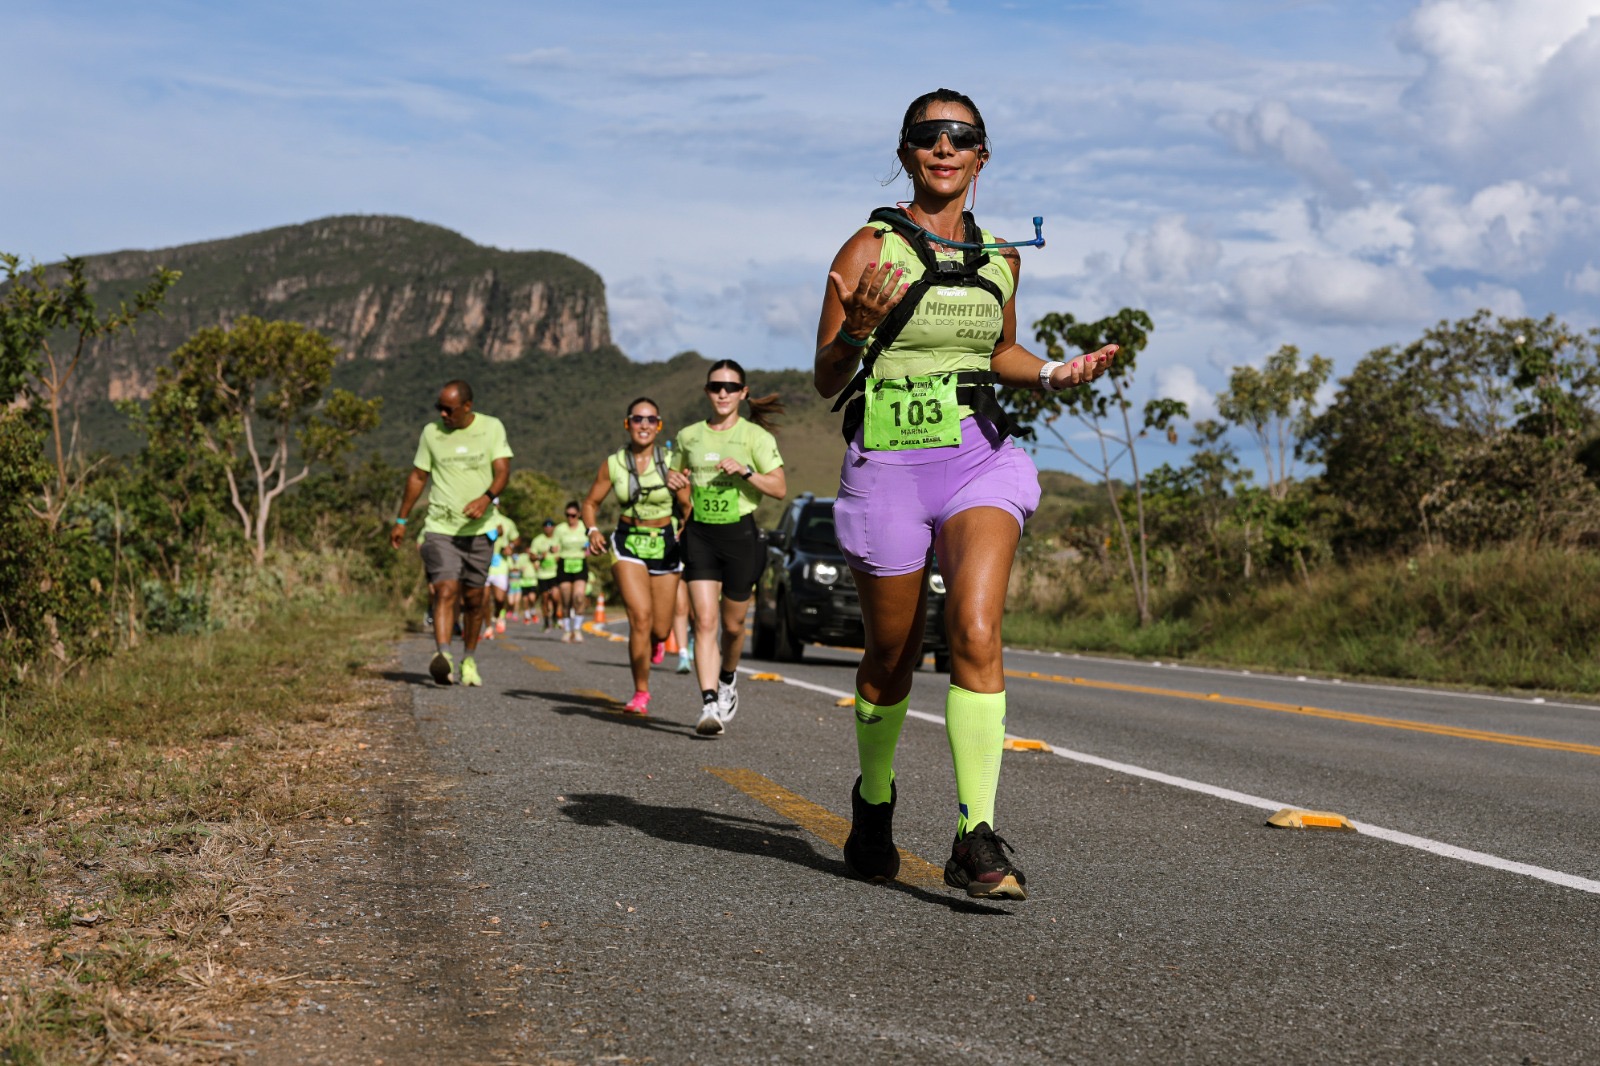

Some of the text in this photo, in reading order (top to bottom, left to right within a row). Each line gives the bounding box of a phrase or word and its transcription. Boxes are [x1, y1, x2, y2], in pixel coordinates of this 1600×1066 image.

[925, 301, 999, 318] MARATONA
[935, 318, 955, 327] DOS
[956, 329, 998, 341] CAIXA
[889, 398, 943, 427] 103
[900, 428, 929, 436] MARINA
[703, 499, 729, 513] 332
